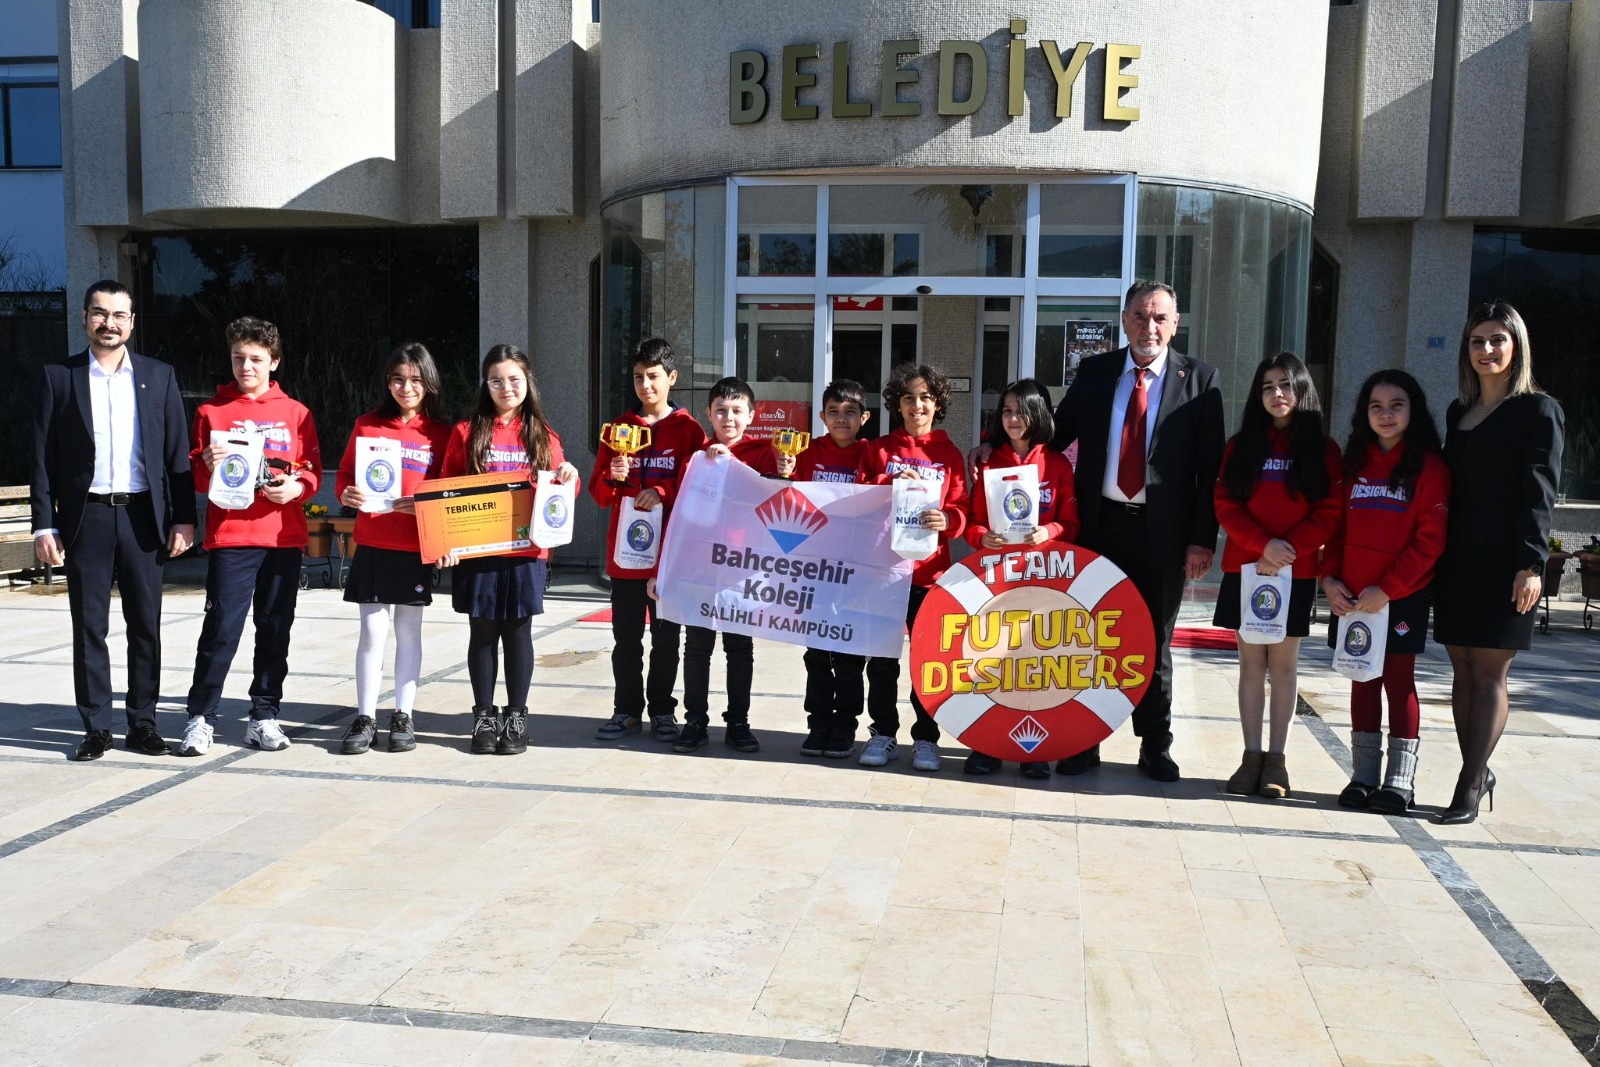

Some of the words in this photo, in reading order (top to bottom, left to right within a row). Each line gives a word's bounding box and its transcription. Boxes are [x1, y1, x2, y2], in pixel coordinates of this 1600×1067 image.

[729, 19, 1142, 125] BELEDİYE
[445, 501, 497, 515] TEBRİKLER!
[711, 543, 855, 585] Bahçeşehir
[980, 550, 1075, 585] TEAM
[743, 578, 815, 615] Koleji
[700, 602, 764, 627] SALİHLİ
[768, 615, 854, 642] KAMPÜSÜ
[940, 608, 1123, 652] FUTURE
[921, 655, 1146, 695] DESIGNERS
